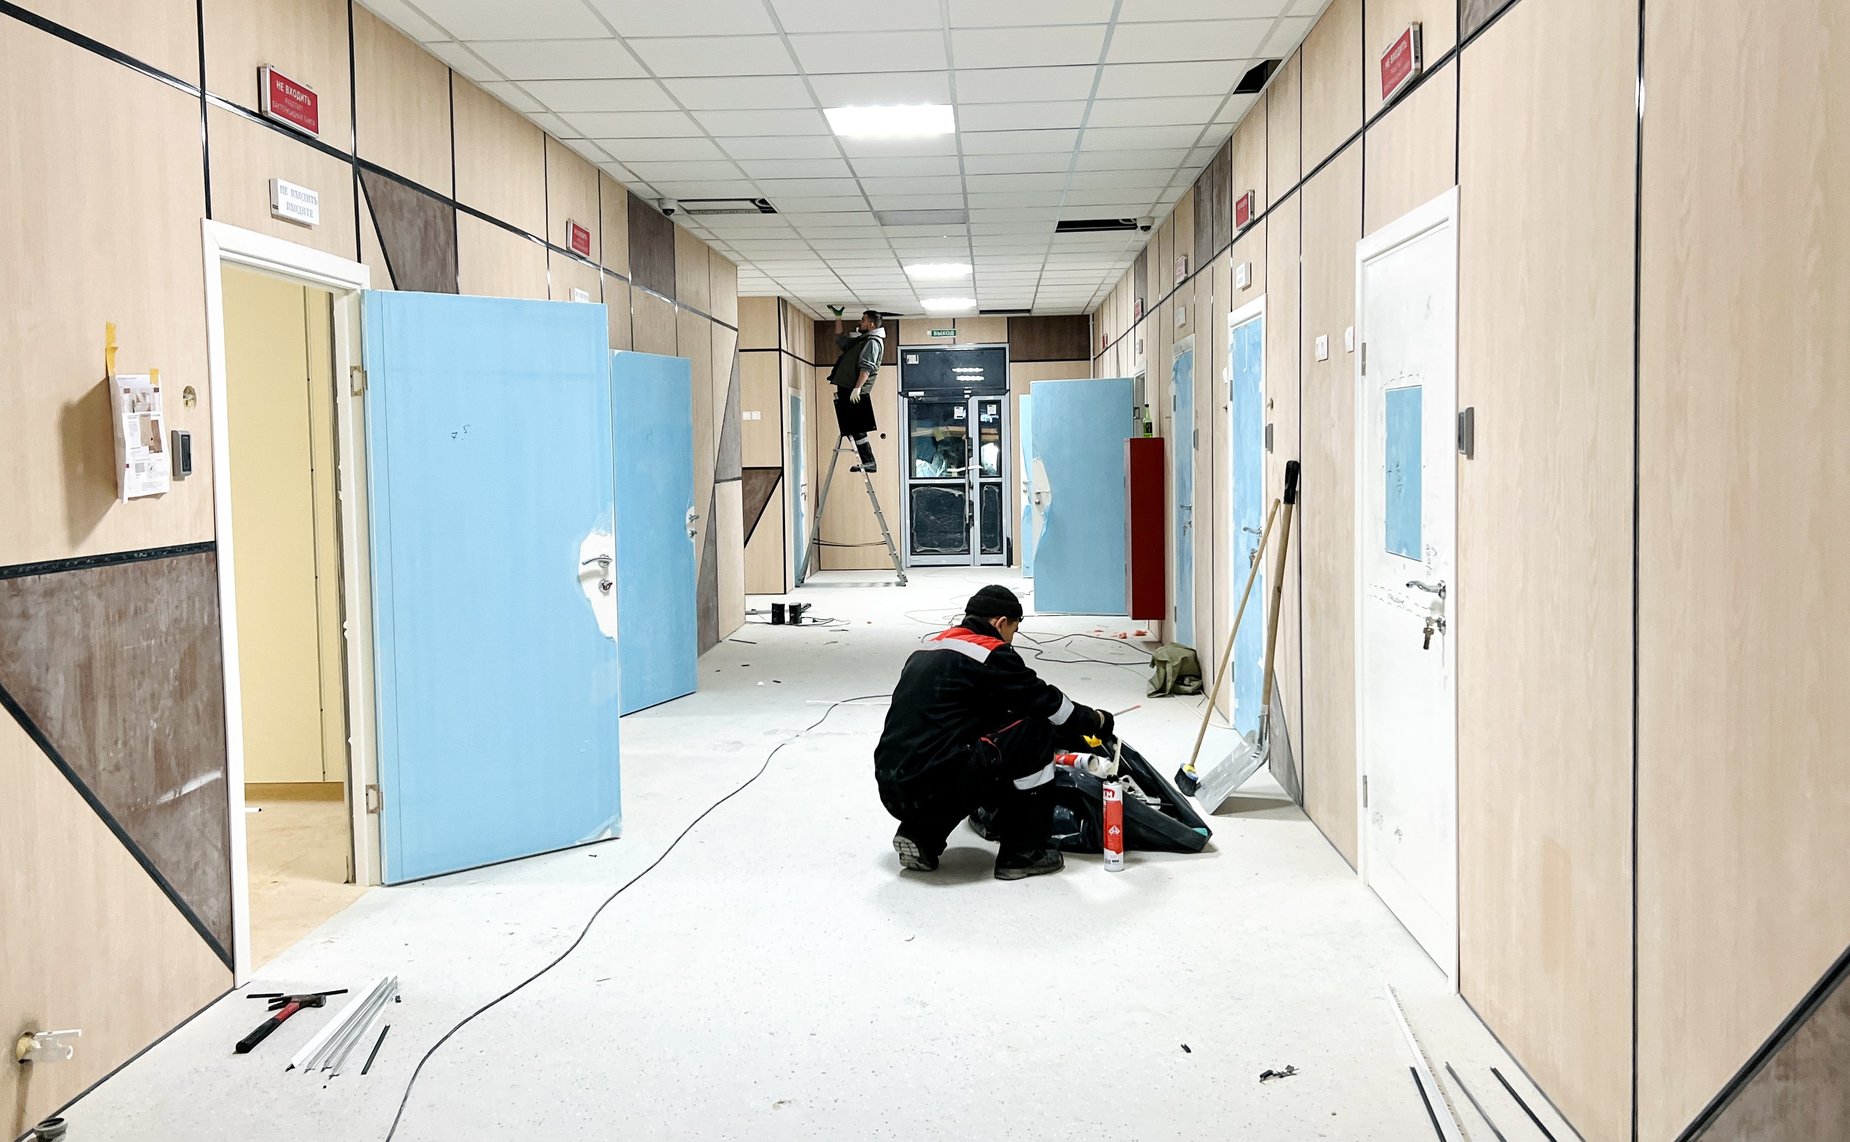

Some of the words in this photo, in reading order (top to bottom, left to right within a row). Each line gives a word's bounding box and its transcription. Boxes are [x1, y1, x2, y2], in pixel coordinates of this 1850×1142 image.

[276, 80, 285, 92] НЕ
[285, 84, 312, 106] ВХОДИТЬ
[279, 184, 289, 197] НЕ
[290, 188, 318, 205] ВХОДИТЬ
